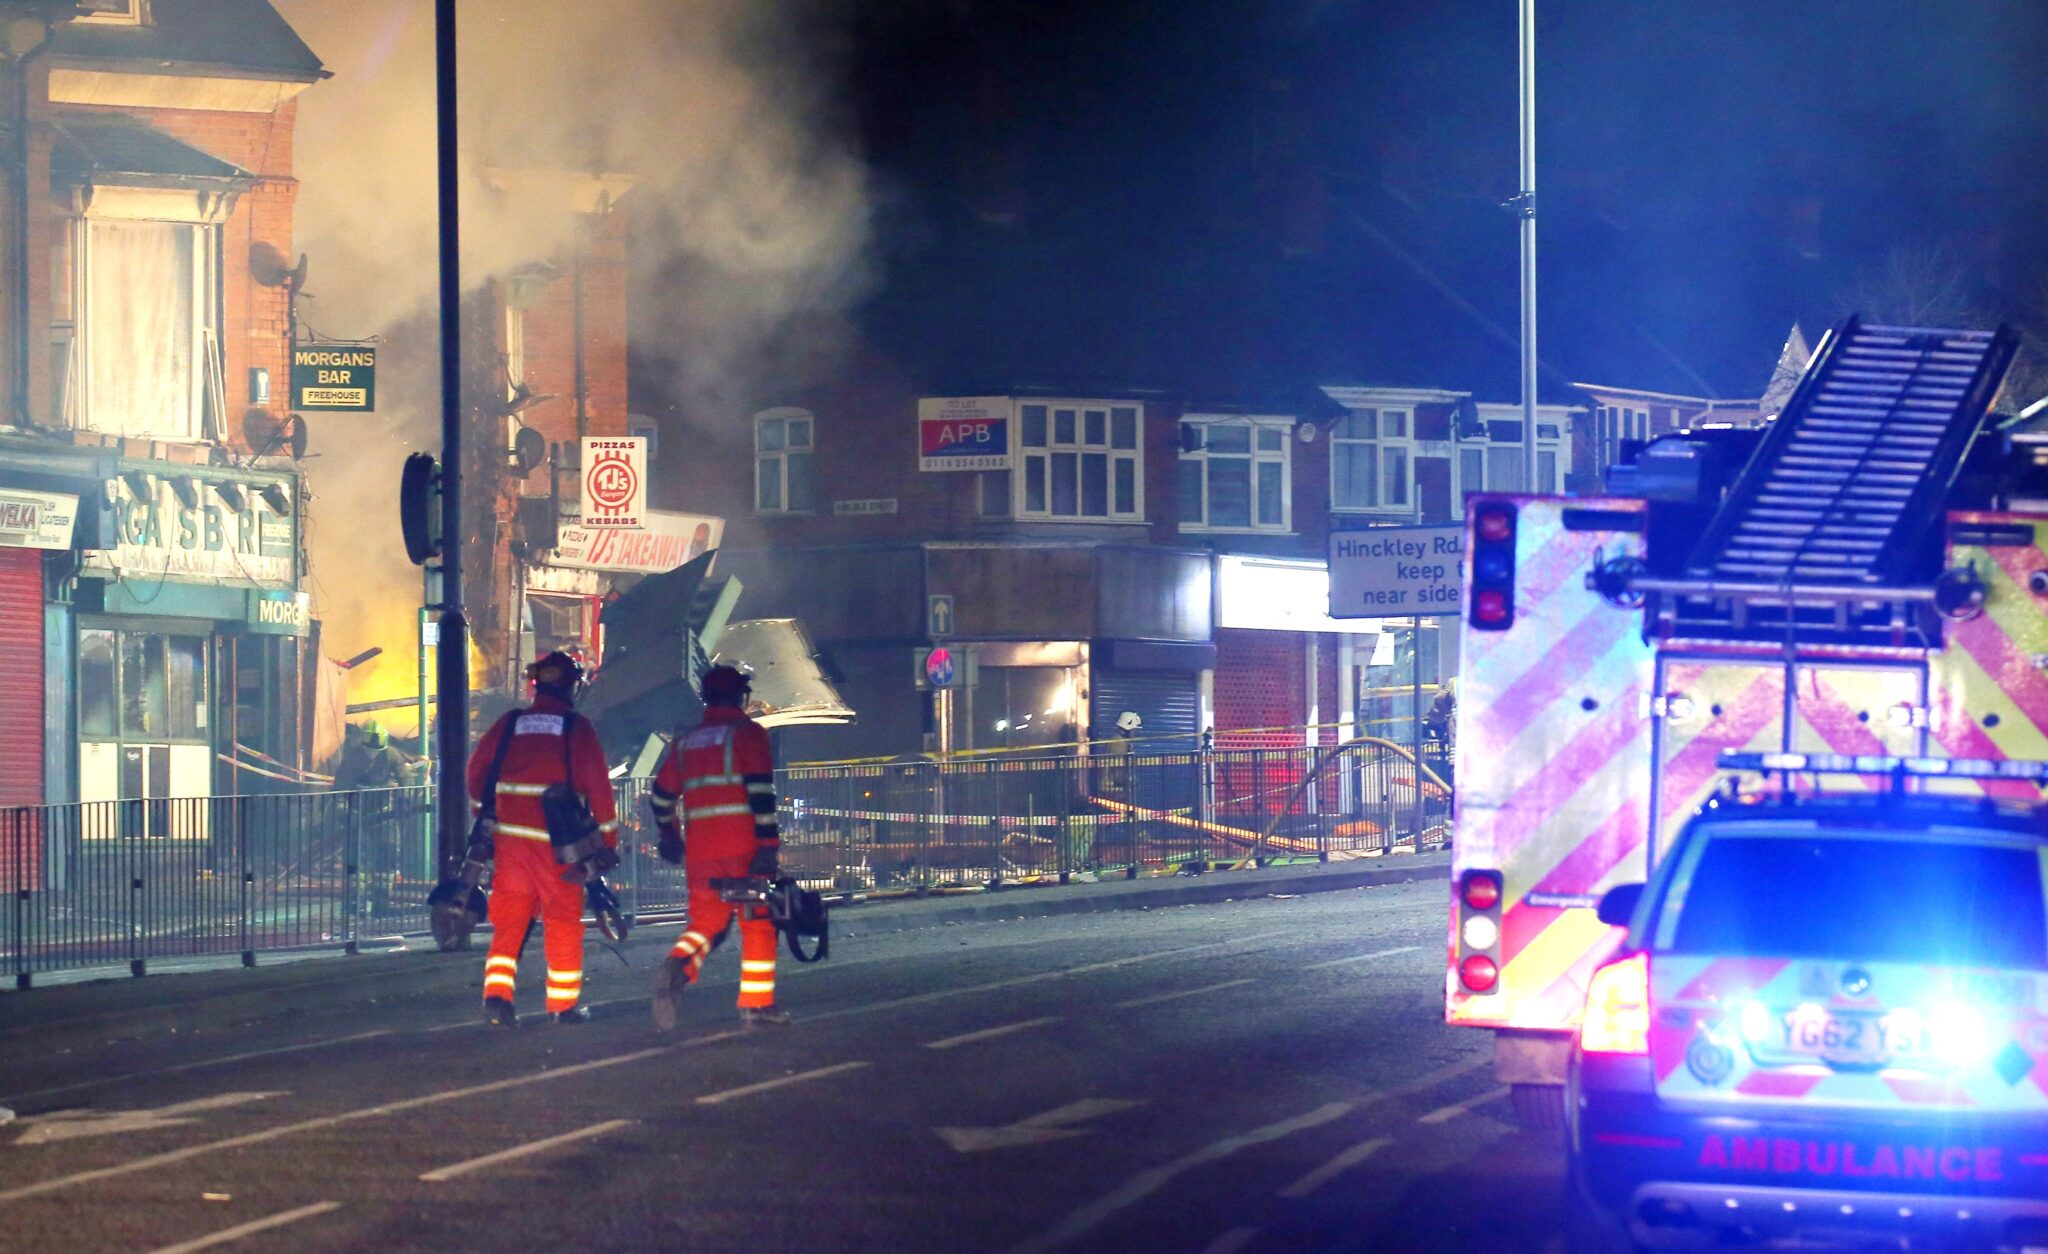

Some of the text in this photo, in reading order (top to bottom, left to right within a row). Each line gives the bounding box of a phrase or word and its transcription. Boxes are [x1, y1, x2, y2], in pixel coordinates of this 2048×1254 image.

[295, 352, 374, 366] MORGANS
[318, 370, 351, 384] BAR
[308, 391, 361, 399] FREEHOUSE
[939, 424, 991, 443] APB
[617, 532, 690, 568] TAKEAWAY
[1337, 536, 1464, 559] Hinckley Rd.
[1397, 561, 1445, 583] keep
[1364, 584, 1459, 604] near side
[1782, 1018, 1863, 1050] YG62
[1700, 1135, 2004, 1182] AMBULANCE
